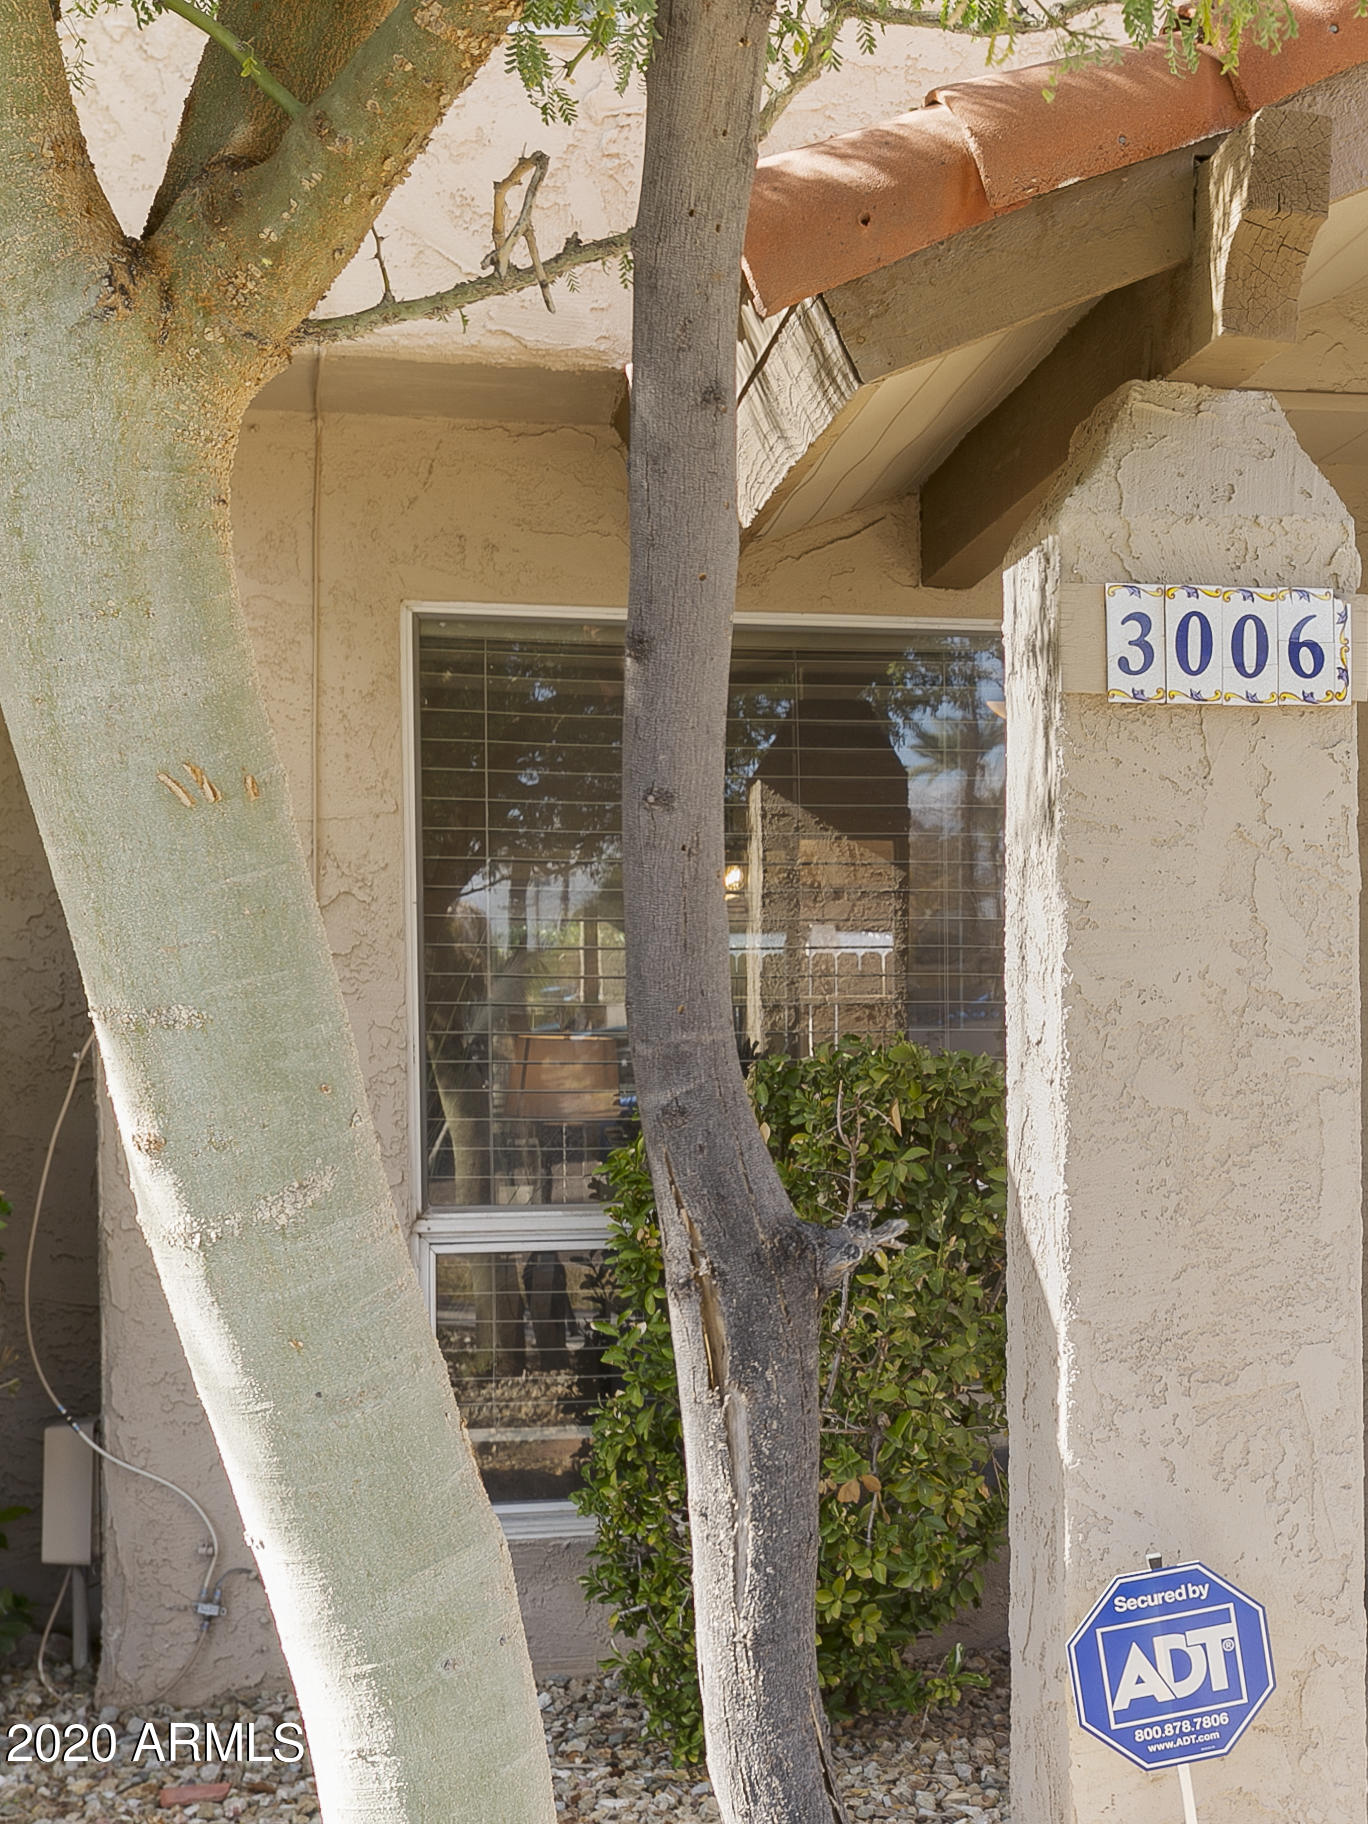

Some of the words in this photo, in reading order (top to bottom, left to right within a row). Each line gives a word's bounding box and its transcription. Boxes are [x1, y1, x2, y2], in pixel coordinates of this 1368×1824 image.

[1117, 610, 1325, 679] 3006
[1113, 1584, 1187, 1613] Secured
[1188, 1582, 1210, 1601] by
[1112, 1622, 1235, 1712] ADT
[1134, 1711, 1230, 1743] 800.878.7806
[1147, 1730, 1220, 1753] www.ADT.com
